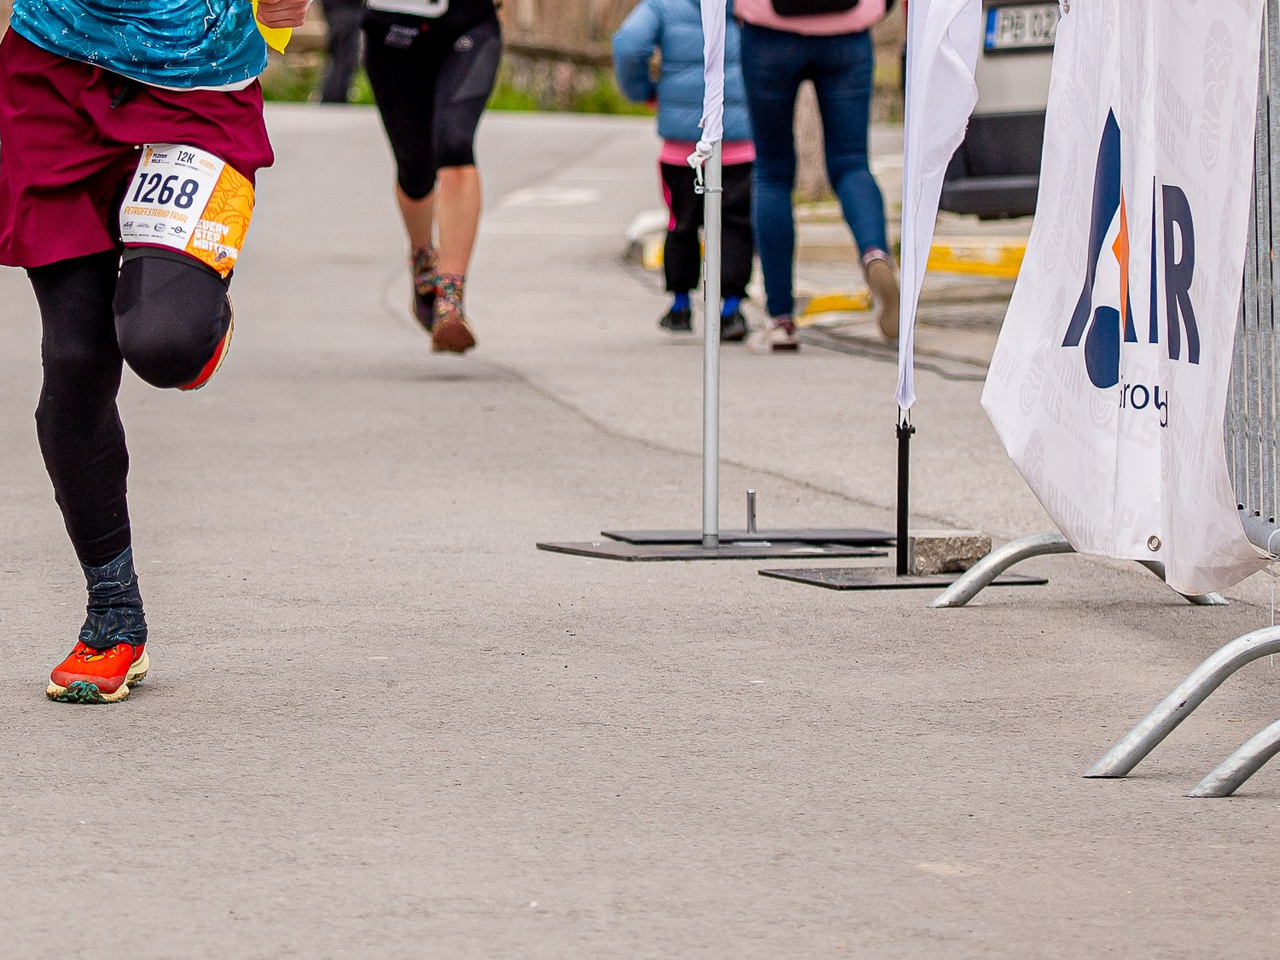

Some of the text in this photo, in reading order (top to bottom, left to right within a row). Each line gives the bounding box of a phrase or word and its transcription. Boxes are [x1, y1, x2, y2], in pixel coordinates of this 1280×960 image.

[176, 150, 195, 164] 12K
[132, 173, 199, 209] 1268
[193, 229, 221, 243] STEP
